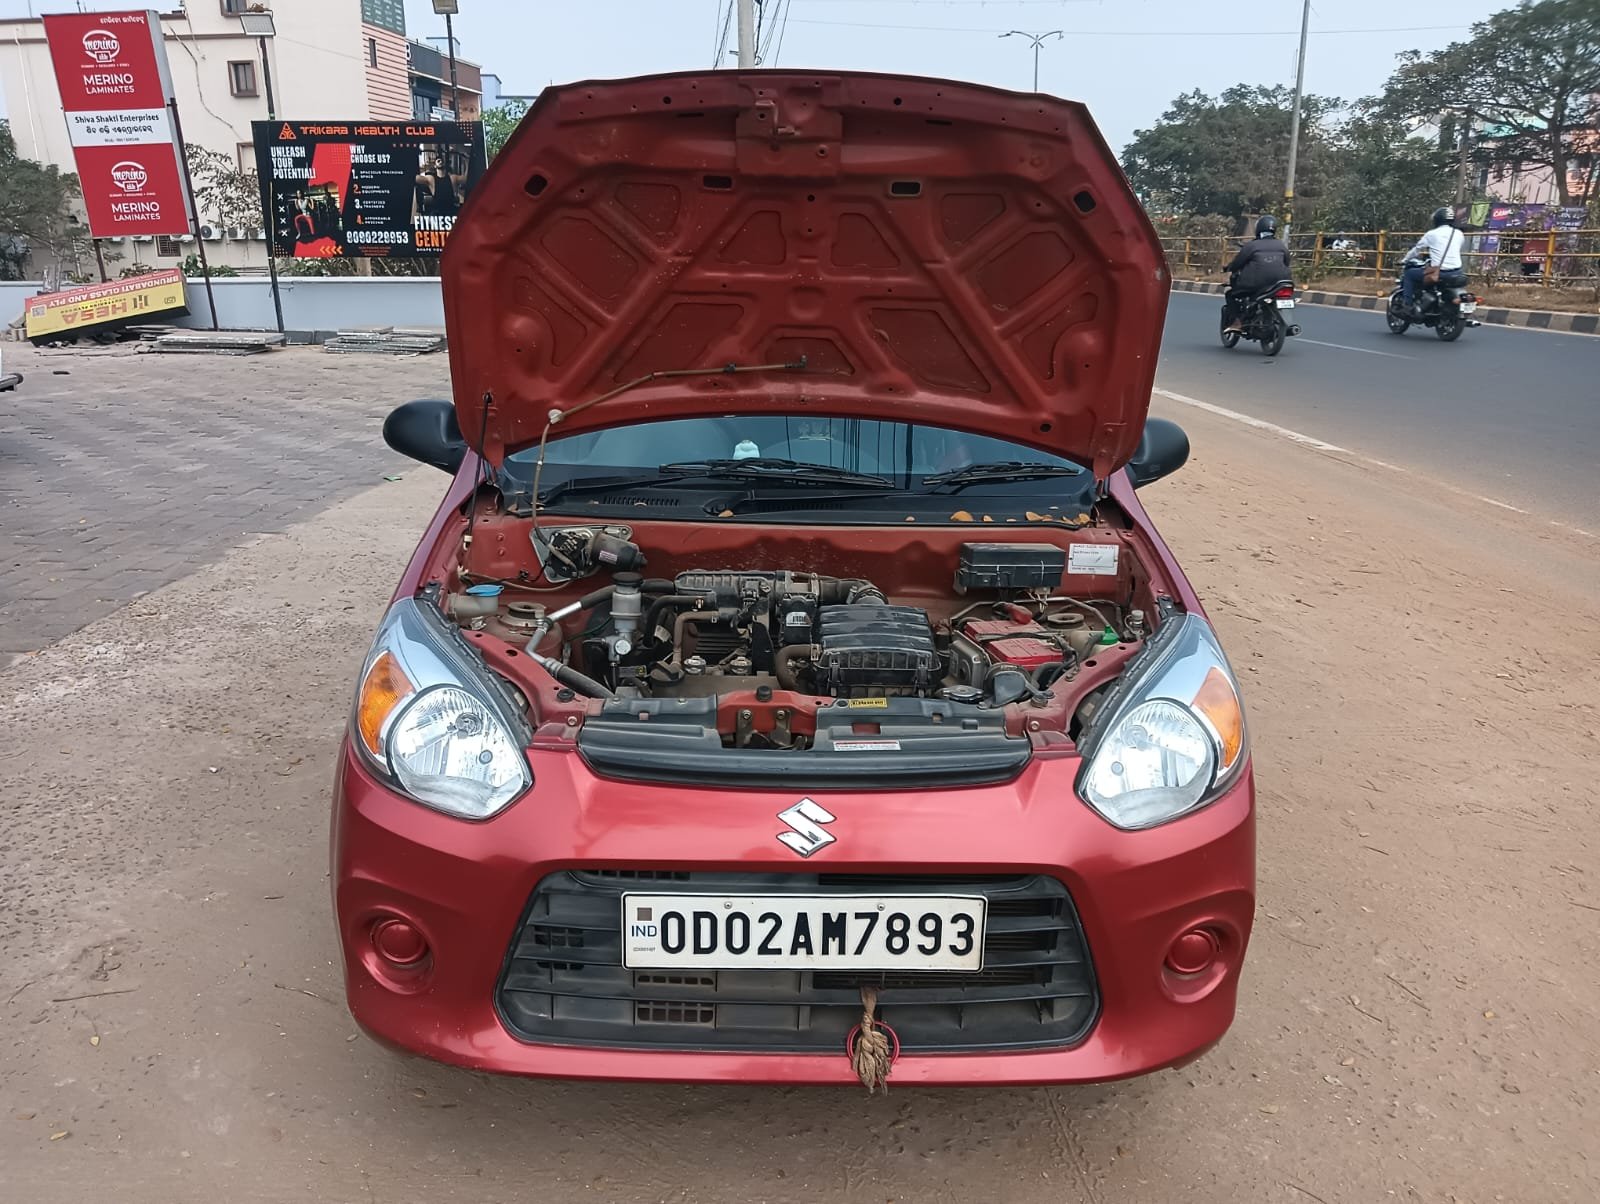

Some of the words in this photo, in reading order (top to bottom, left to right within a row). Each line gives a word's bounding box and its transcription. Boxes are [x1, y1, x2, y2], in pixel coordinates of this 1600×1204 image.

[83, 73, 133, 85] MERINO
[86, 85, 135, 95] LAMINATES
[75, 116, 95, 124] Shiva
[96, 114, 119, 123] Shakti
[120, 114, 159, 122] Enterprises
[354, 126, 400, 135] HEALTH
[405, 126, 435, 135] CLUB
[270, 146, 306, 158] UNLEASH
[350, 145, 365, 155] WHY
[272, 157, 294, 168] YOUR
[350, 154, 377, 164] CHOOSE
[378, 154, 391, 164] US?
[111, 201, 160, 213] MERINO
[114, 213, 160, 222] LAMINATES
[415, 231, 450, 247] CENT
[68, 293, 88, 304] AND
[89, 287, 120, 299] GLASS
[49, 298, 66, 308] PLY
[62, 302, 128, 324] HESA
[631, 925, 657, 937] IND
[660, 911, 975, 957] OD02AM7893
